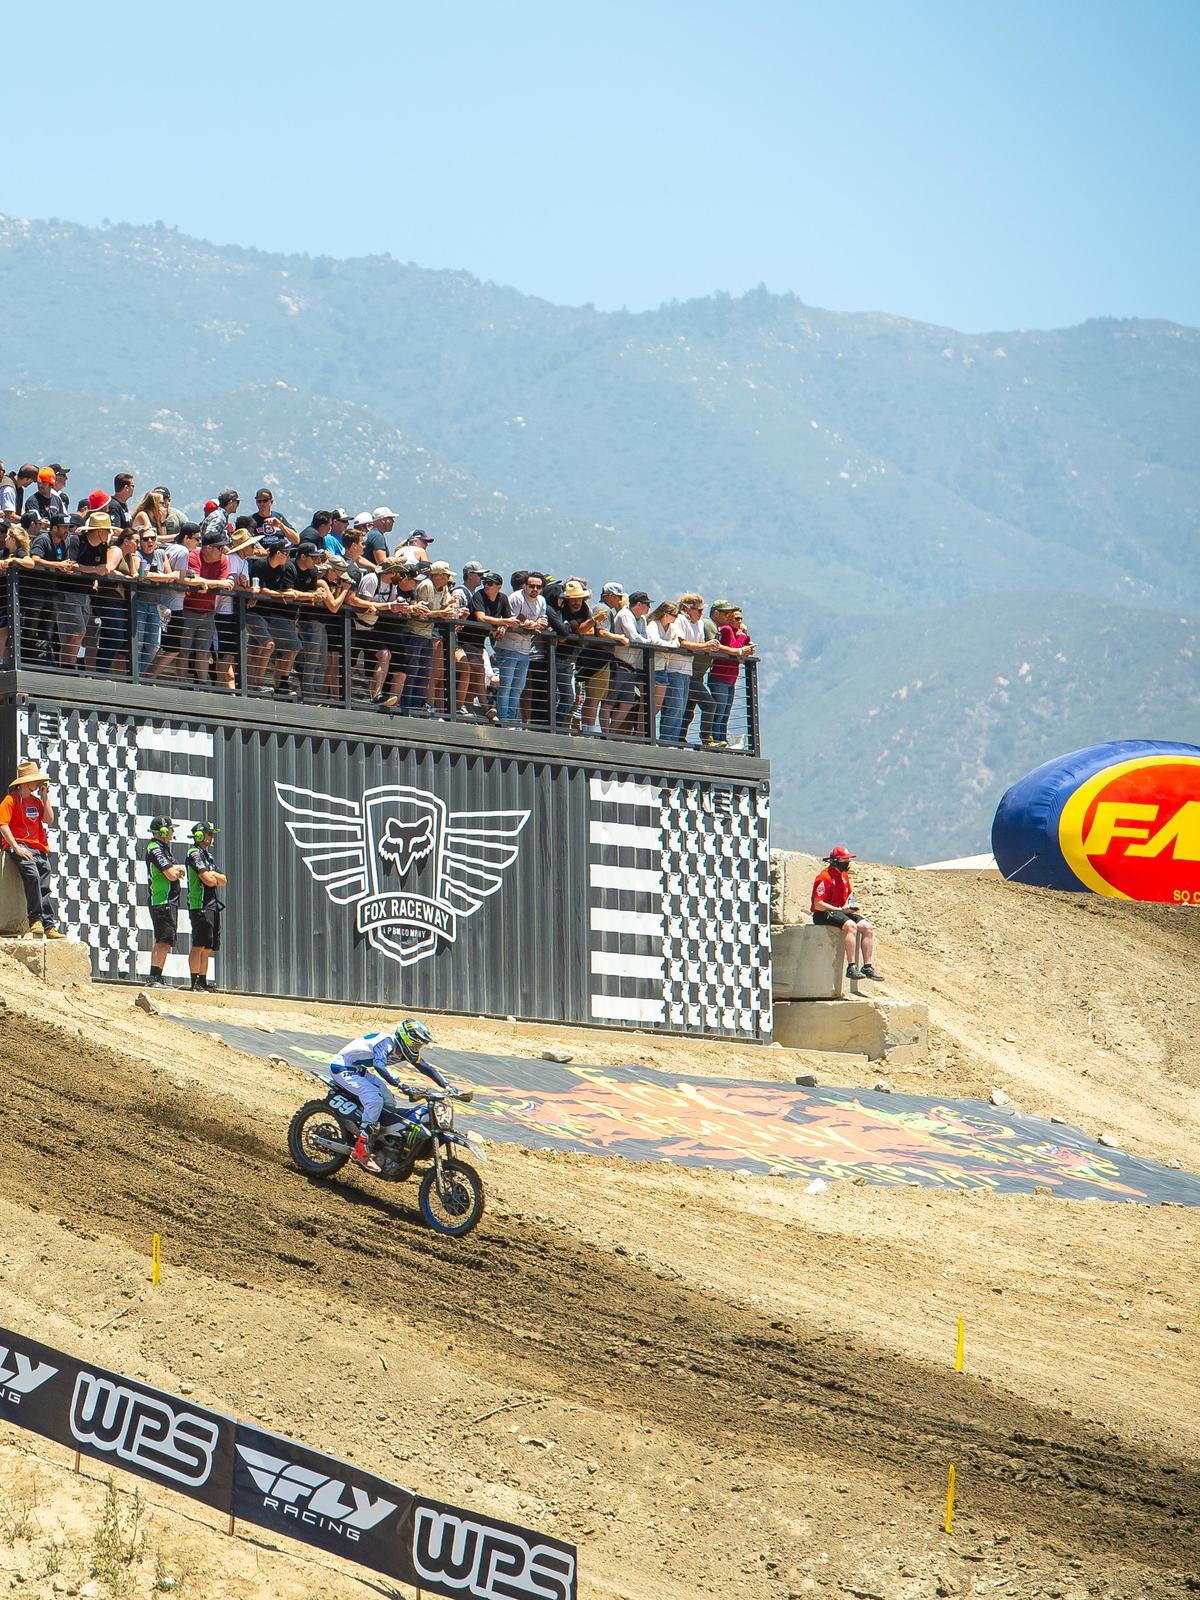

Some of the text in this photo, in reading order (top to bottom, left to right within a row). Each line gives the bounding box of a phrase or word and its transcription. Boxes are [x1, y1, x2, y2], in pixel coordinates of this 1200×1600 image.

[364, 899, 450, 931] FOX RACEWAY
[328, 1094, 358, 1115] 59
[69, 1370, 218, 1487] WPS
[236, 1443, 397, 1530] FLY
[264, 1497, 360, 1542] RACING
[413, 1507, 576, 1600] WPS
